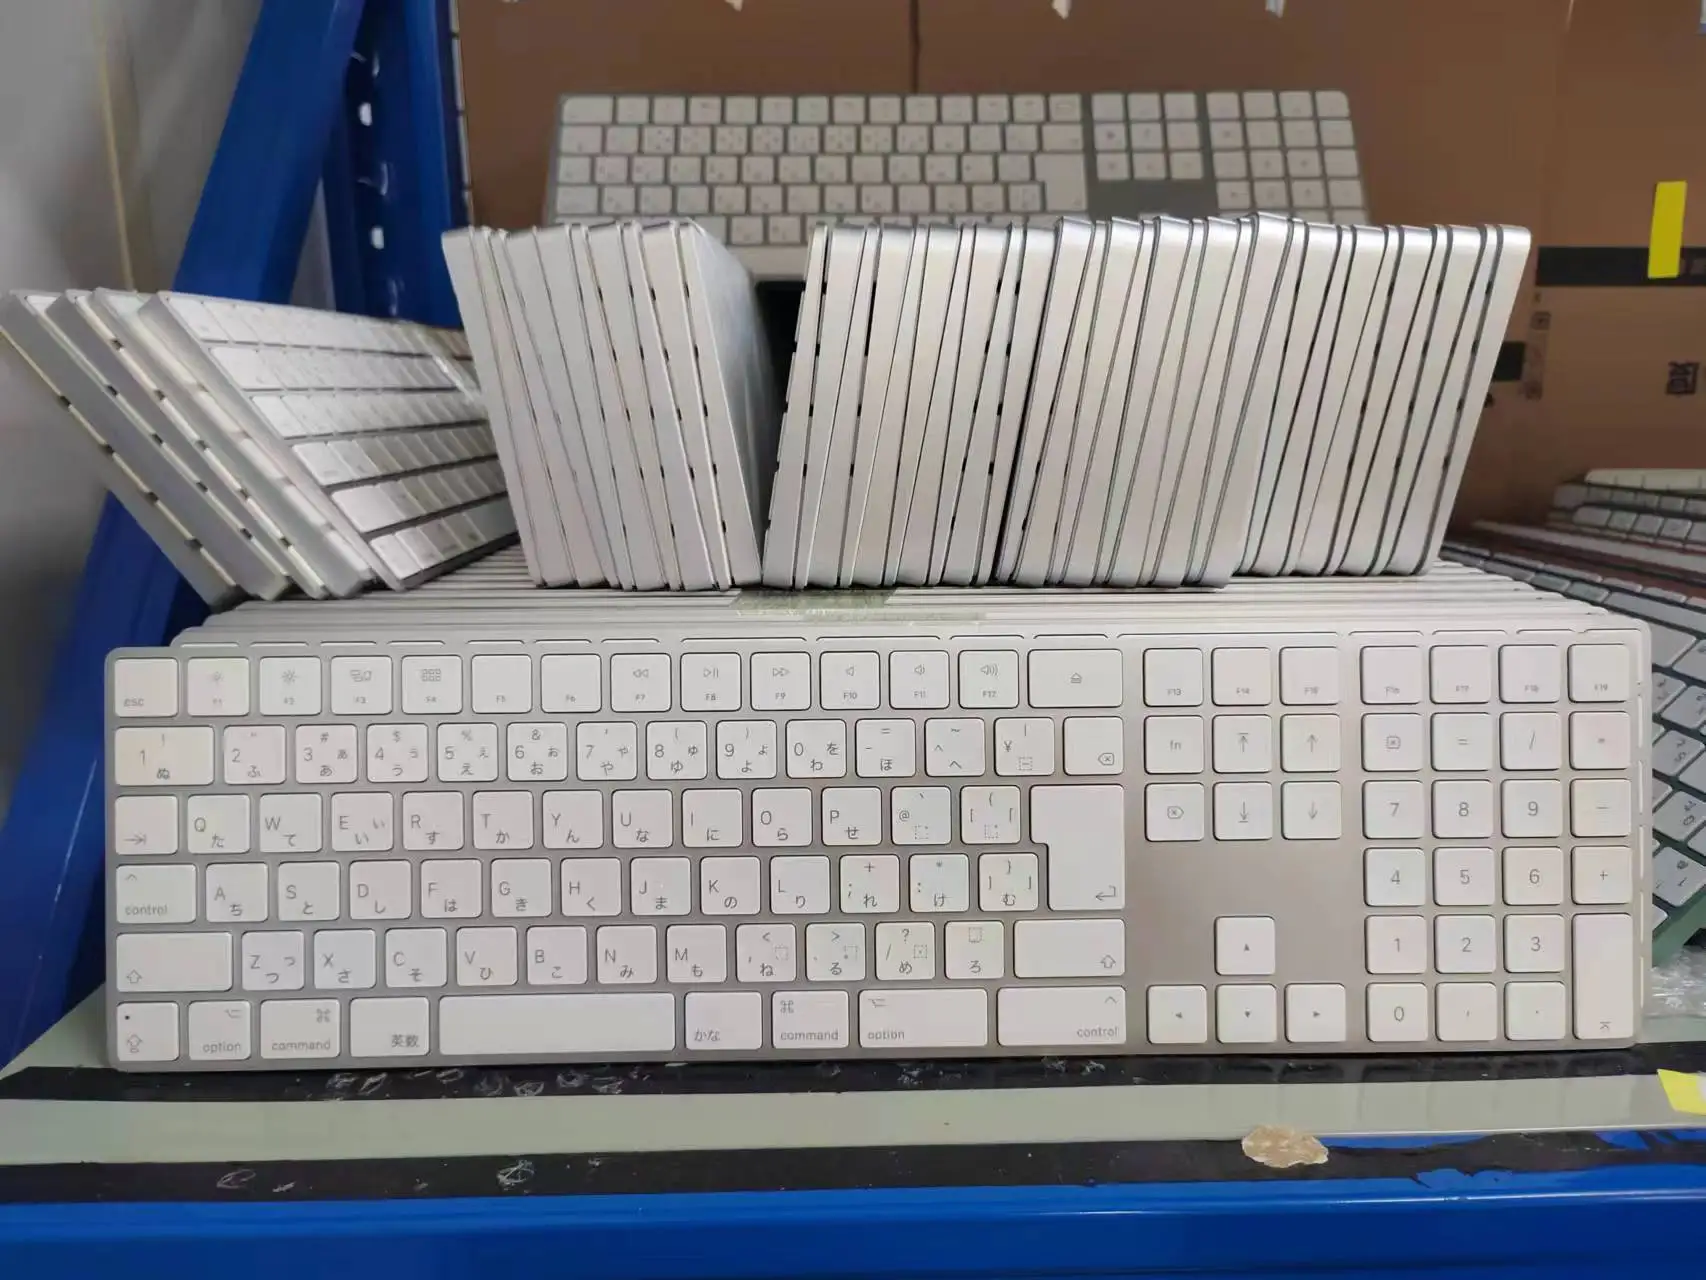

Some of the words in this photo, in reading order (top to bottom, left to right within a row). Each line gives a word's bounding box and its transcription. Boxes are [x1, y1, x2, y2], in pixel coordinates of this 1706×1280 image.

[705, 692, 717, 701] F8
[775, 691, 787, 700] F9
[843, 691, 858, 700] F10
[913, 690, 926, 699] F11
[123, 697, 145, 708] esc
[319, 731, 330, 743] #
[392, 730, 401, 743] $
[460, 729, 473, 742] %
[531, 729, 542, 741] &
[514, 744, 525, 760] 6
[585, 744, 595, 760] 7
[654, 743, 665, 759] 8
[724, 743, 735, 758] 9
[826, 741, 839, 756] を
[1169, 739, 1182, 751] fn
[139, 749, 146, 765] 1
[231, 749, 241, 763] 2
[303, 748, 313, 762] 3
[374, 748, 385, 761] 4
[444, 745, 455, 761] 5
[247, 764, 261, 779] ふ
[319, 764, 333, 777] あ
[391, 764, 404, 777] う
[460, 762, 474, 776] え
[529, 761, 544, 776] お
[599, 760, 615, 775] や
[670, 759, 684, 774] ゆ
[741, 759, 753, 773] よ
[809, 758, 824, 772] わ
[879, 758, 893, 772] ほ
[156, 767, 171, 781] ぬ
[898, 809, 910, 823] @
[1389, 802, 1400, 817] 7
[1458, 801, 1470, 817] 8
[1527, 800, 1539, 817] 9
[193, 816, 207, 833] Q
[264, 816, 281, 831] W
[338, 815, 350, 831] E
[410, 813, 422, 829] R
[480, 813, 492, 829] T
[550, 812, 562, 827] Y
[620, 812, 632, 828] U
[829, 809, 840, 825] P
[211, 833, 225, 849] た
[282, 833, 297, 848] て
[354, 833, 370, 846] い
[425, 830, 441, 846] す
[495, 829, 510, 845] か
[565, 830, 580, 844] ん
[635, 828, 650, 843] な
[706, 828, 721, 842] に
[776, 827, 789, 842] ら
[844, 826, 860, 841] せ
[1390, 869, 1401, 885] 4
[1459, 869, 1470, 885] 5
[1528, 868, 1541, 885] 6
[213, 887, 227, 901] A
[285, 884, 297, 900] S
[356, 883, 370, 899] D
[427, 881, 438, 897] F
[498, 880, 512, 897] G
[568, 880, 581, 896] H
[638, 880, 648, 895] J
[708, 879, 720, 894] K
[777, 879, 786, 894] L
[443, 898, 459, 913] は
[515, 897, 529, 912] き
[585, 896, 596, 912] く
[655, 895, 669, 911] ま
[723, 895, 738, 909] の
[795, 895, 806, 909] り
[863, 893, 878, 907] れ
[933, 892, 948, 906] け
[1002, 892, 1017, 907] む
[124, 904, 168, 917] control
[229, 903, 243, 917] ち
[302, 901, 314, 916] と
[374, 900, 387, 915] し
[901, 928, 910, 942] ?
[1393, 937, 1402, 953] 1
[1461, 936, 1472, 953] 2
[1530, 936, 1541, 953] 3
[322, 953, 335, 968] X
[392, 951, 406, 967] C
[464, 950, 476, 964] V
[534, 949, 545, 964] B
[604, 948, 617, 964] N
[674, 947, 688, 961] M
[250, 954, 261, 970] Z
[759, 962, 774, 977] ね
[829, 961, 843, 976] る
[898, 960, 913, 975] め
[968, 959, 982, 974] ろ
[266, 971, 280, 984] つ
[337, 968, 352, 984] さ
[408, 967, 423, 983] そ
[479, 967, 494, 981] ひ
[551, 965, 564, 979] こ
[619, 964, 634, 979] み
[691, 963, 704, 978] も
[693, 1028, 721, 1043] かな
[780, 1029, 839, 1041] command
[867, 1029, 905, 1042] option
[1076, 1026, 1118, 1038] control
[202, 1041, 242, 1055] option
[271, 1040, 331, 1052] command
[391, 1034, 419, 1048] 英数
